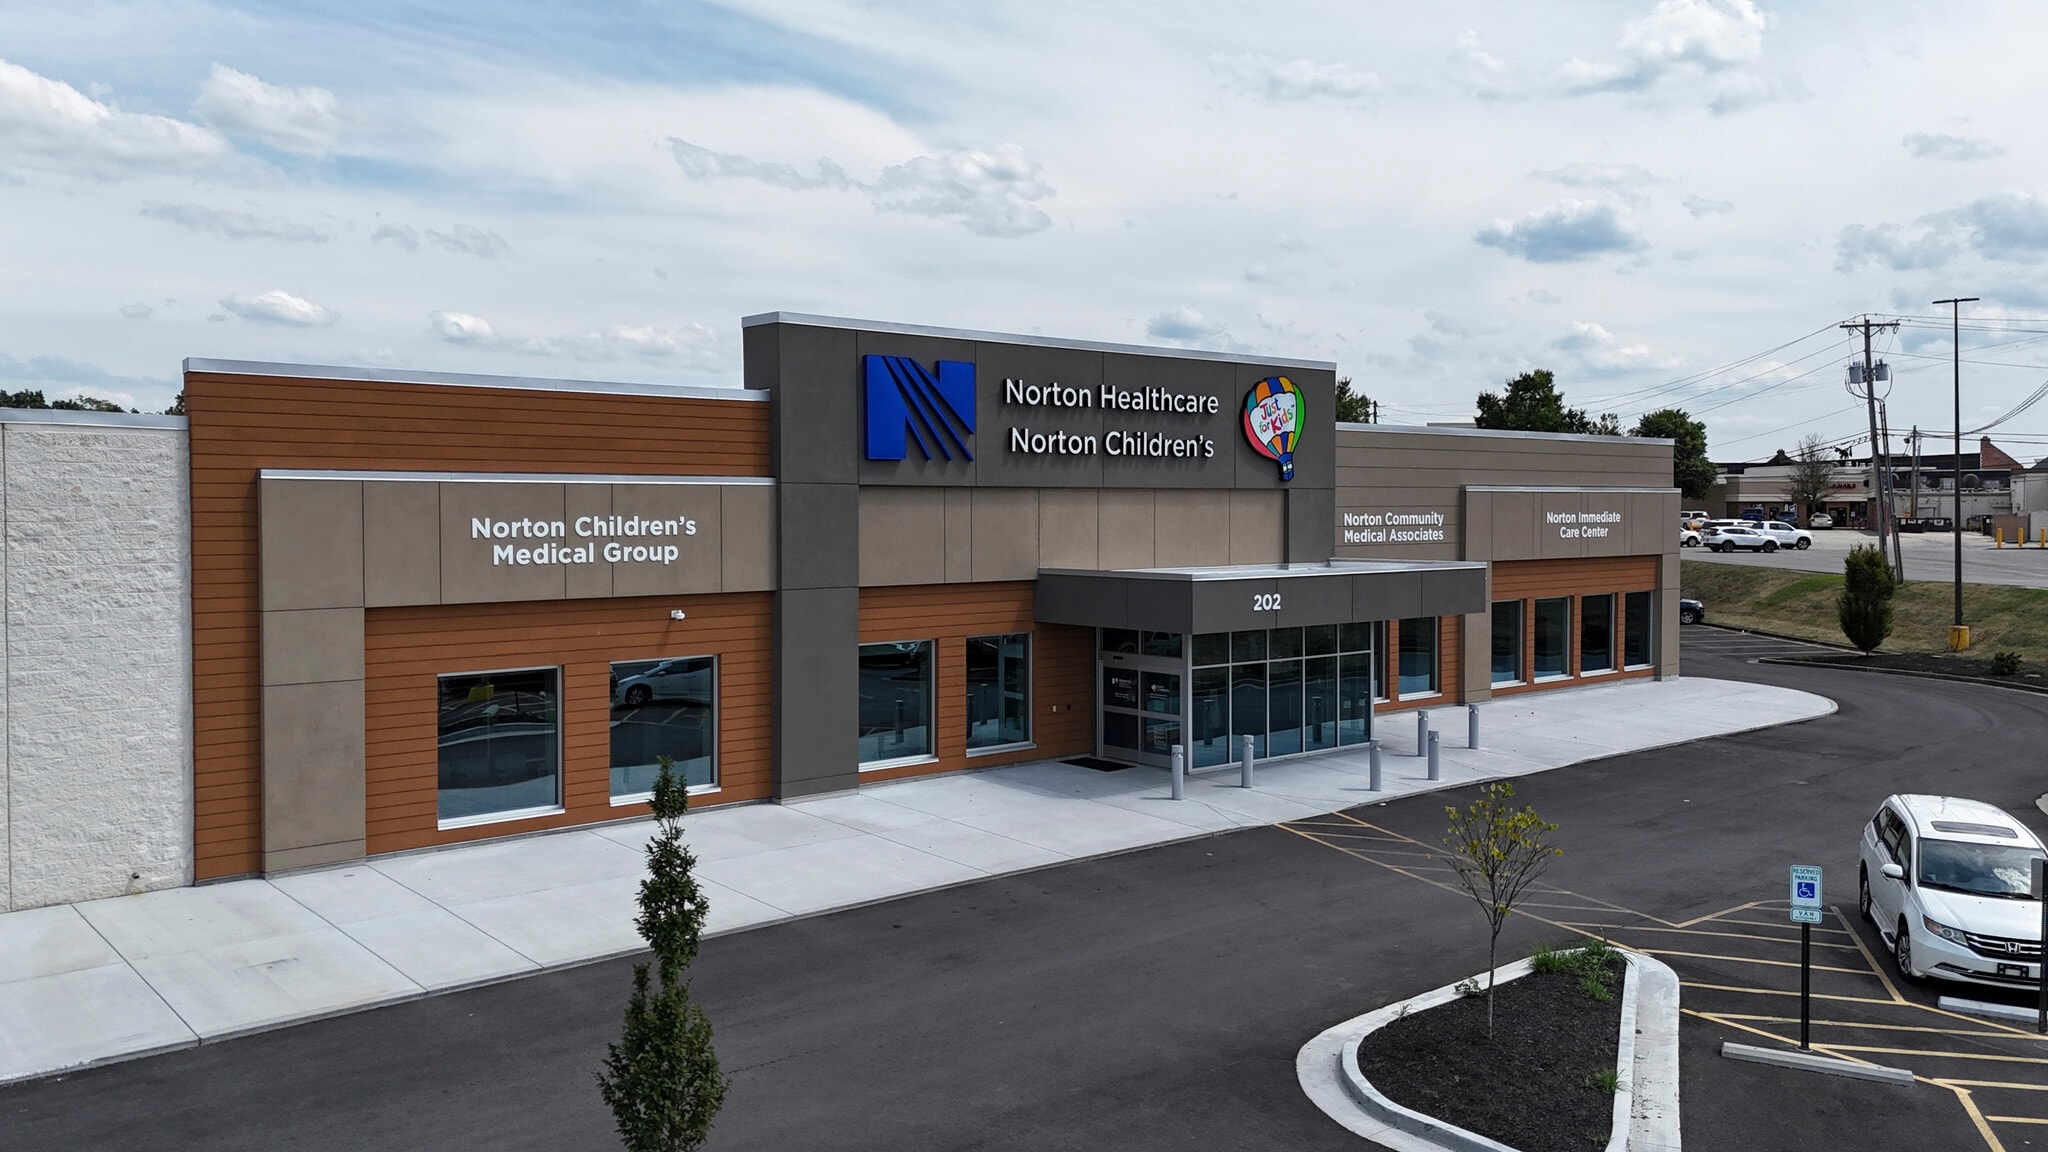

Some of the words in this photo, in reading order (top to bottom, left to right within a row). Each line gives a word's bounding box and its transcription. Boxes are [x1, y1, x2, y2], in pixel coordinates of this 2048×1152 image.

[1005, 378, 1092, 407] Norton
[1100, 384, 1219, 414] Healthcare
[1259, 397, 1281, 421] Just
[1259, 421, 1270, 434] for
[1270, 407, 1294, 434] Kids
[1011, 427, 1097, 455] Norton
[1105, 430, 1214, 458] Children's
[471, 517, 566, 539] Norton
[574, 515, 697, 538] Children's
[1344, 512, 1382, 526] Norton
[1385, 511, 1444, 527] Community
[1546, 511, 1576, 524] Norton
[1578, 511, 1621, 523] Immediate
[1344, 529, 1386, 543] Medical
[1389, 527, 1444, 542] Associates
[1560, 526, 1580, 538] Care
[1581, 526, 1608, 538] Center
[493, 543, 595, 565] Medical
[603, 543, 679, 565] Group
[1253, 593, 1281, 611] 202
